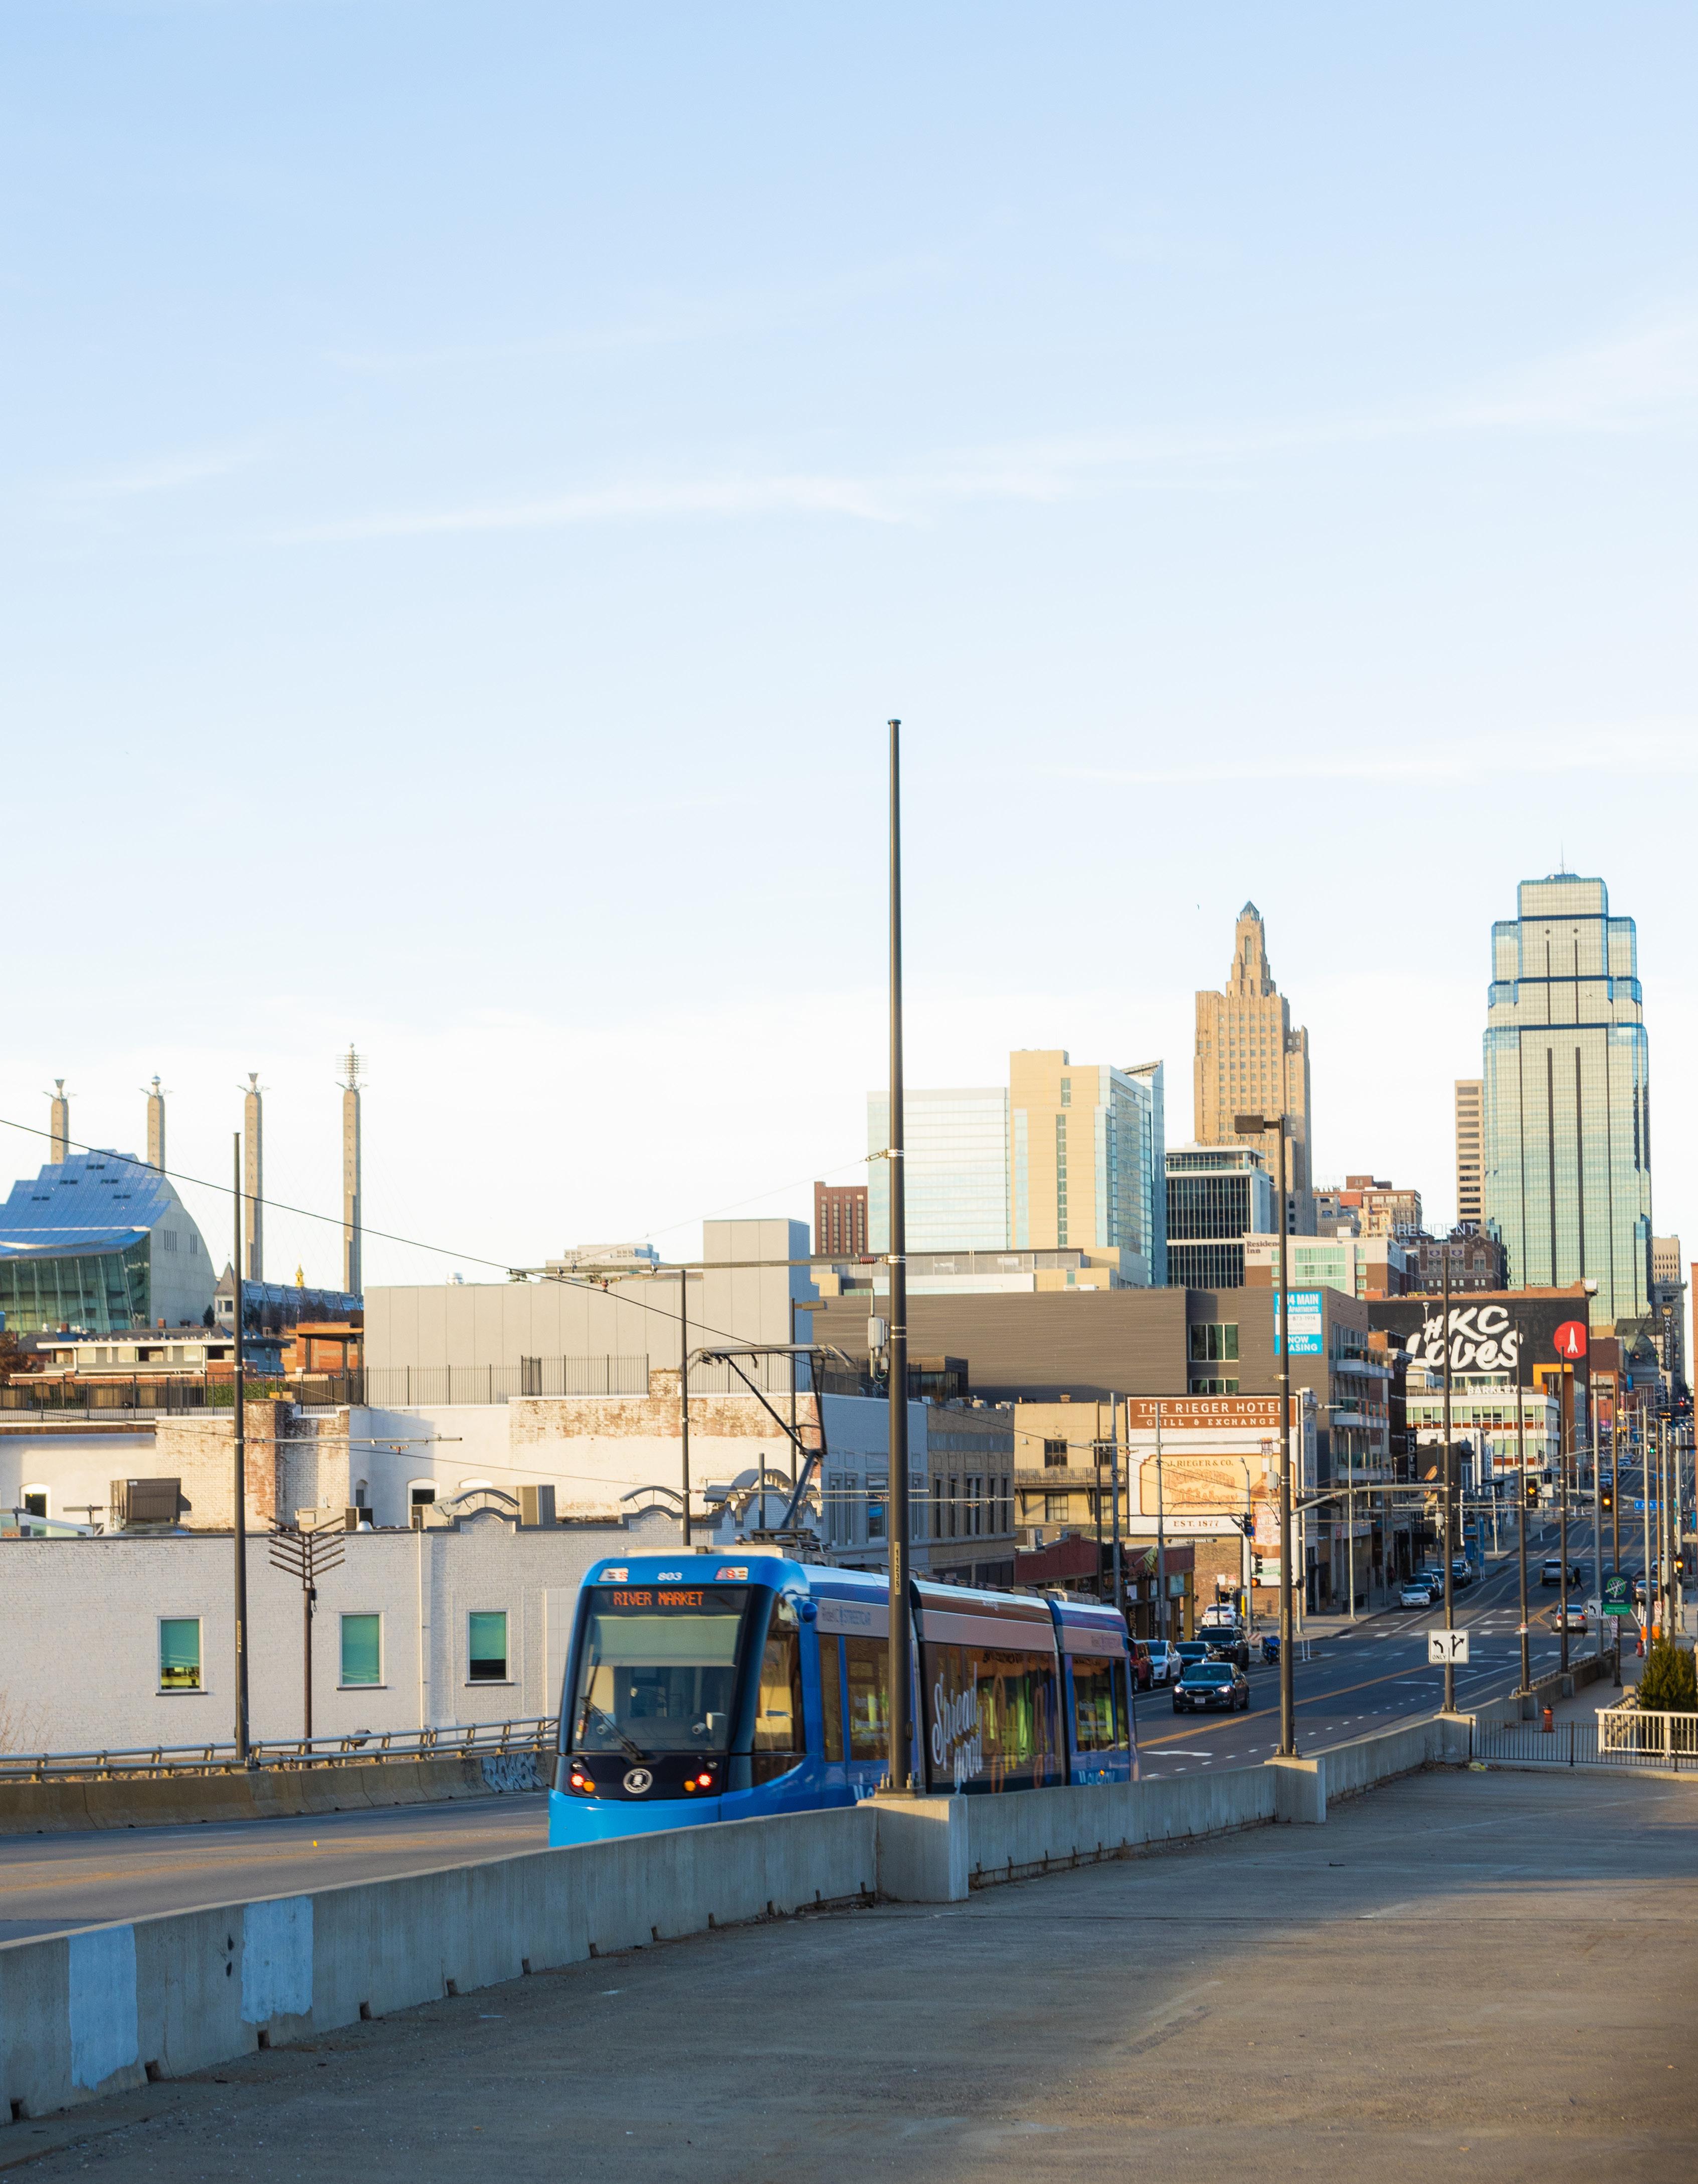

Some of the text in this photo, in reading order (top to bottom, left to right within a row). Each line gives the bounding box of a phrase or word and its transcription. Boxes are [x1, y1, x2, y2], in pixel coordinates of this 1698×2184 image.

[1386, 1222, 1476, 1237] PRESIDENT
[1277, 1294, 1318, 1305] 114 MAIN
[1422, 1305, 1510, 1343] #KC
[1288, 1336, 1309, 1344] NOW
[1288, 1343, 1318, 1352] ASING
[1466, 1385, 1518, 1394] BARKLEY
[1139, 1403, 1168, 1414] THE
[1176, 1402, 1229, 1413] RIEGER
[1146, 1418, 1185, 1426] GILL
[1207, 1418, 1275, 1426] EXCHANGE
[657, 1572, 683, 1581] 803
[613, 1591, 704, 1605] RIVER MARKET
